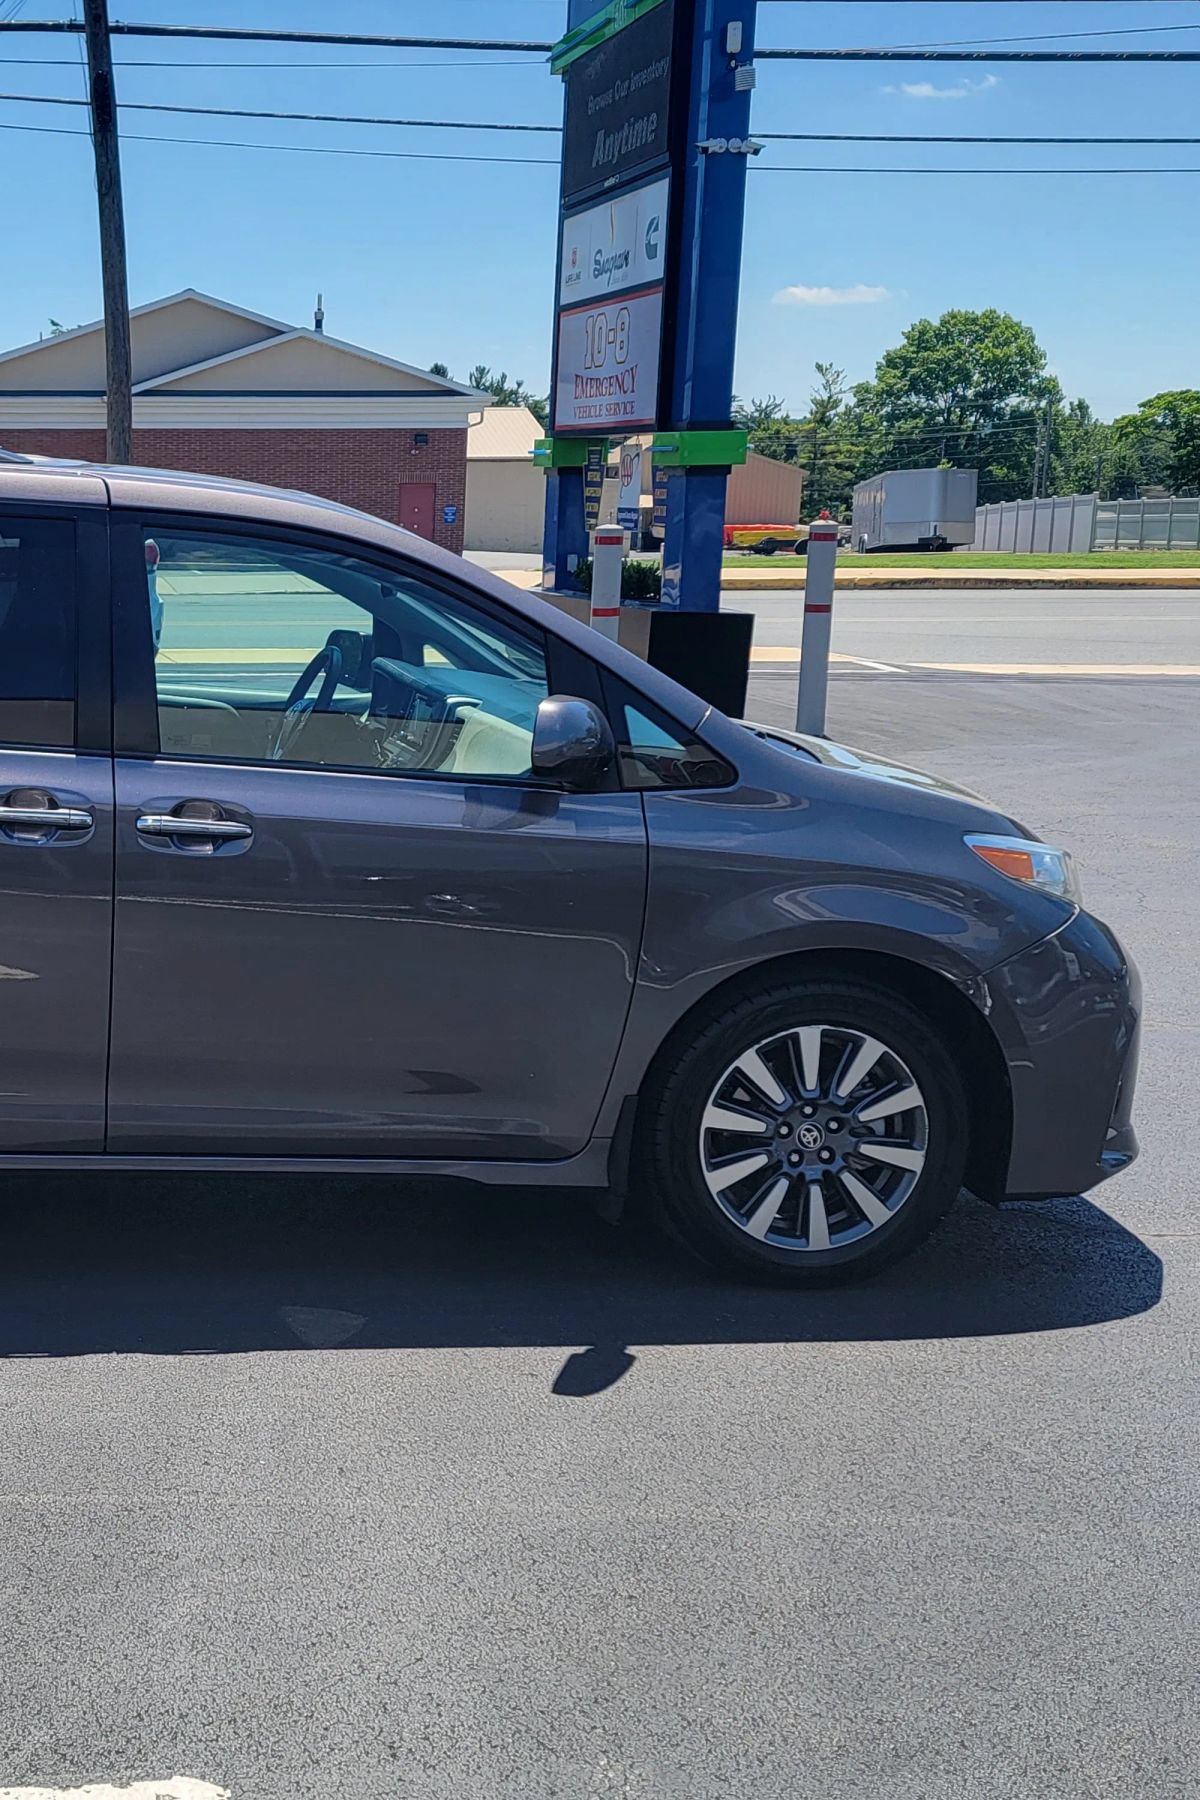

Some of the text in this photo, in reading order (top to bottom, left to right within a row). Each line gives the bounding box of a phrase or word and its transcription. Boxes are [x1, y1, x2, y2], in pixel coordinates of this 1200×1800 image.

[591, 112, 658, 169] Anytime
[584, 306, 631, 370] 10-8
[573, 364, 639, 400] EMERGENCY
[573, 401, 636, 420] VEHICLE SERVICE
